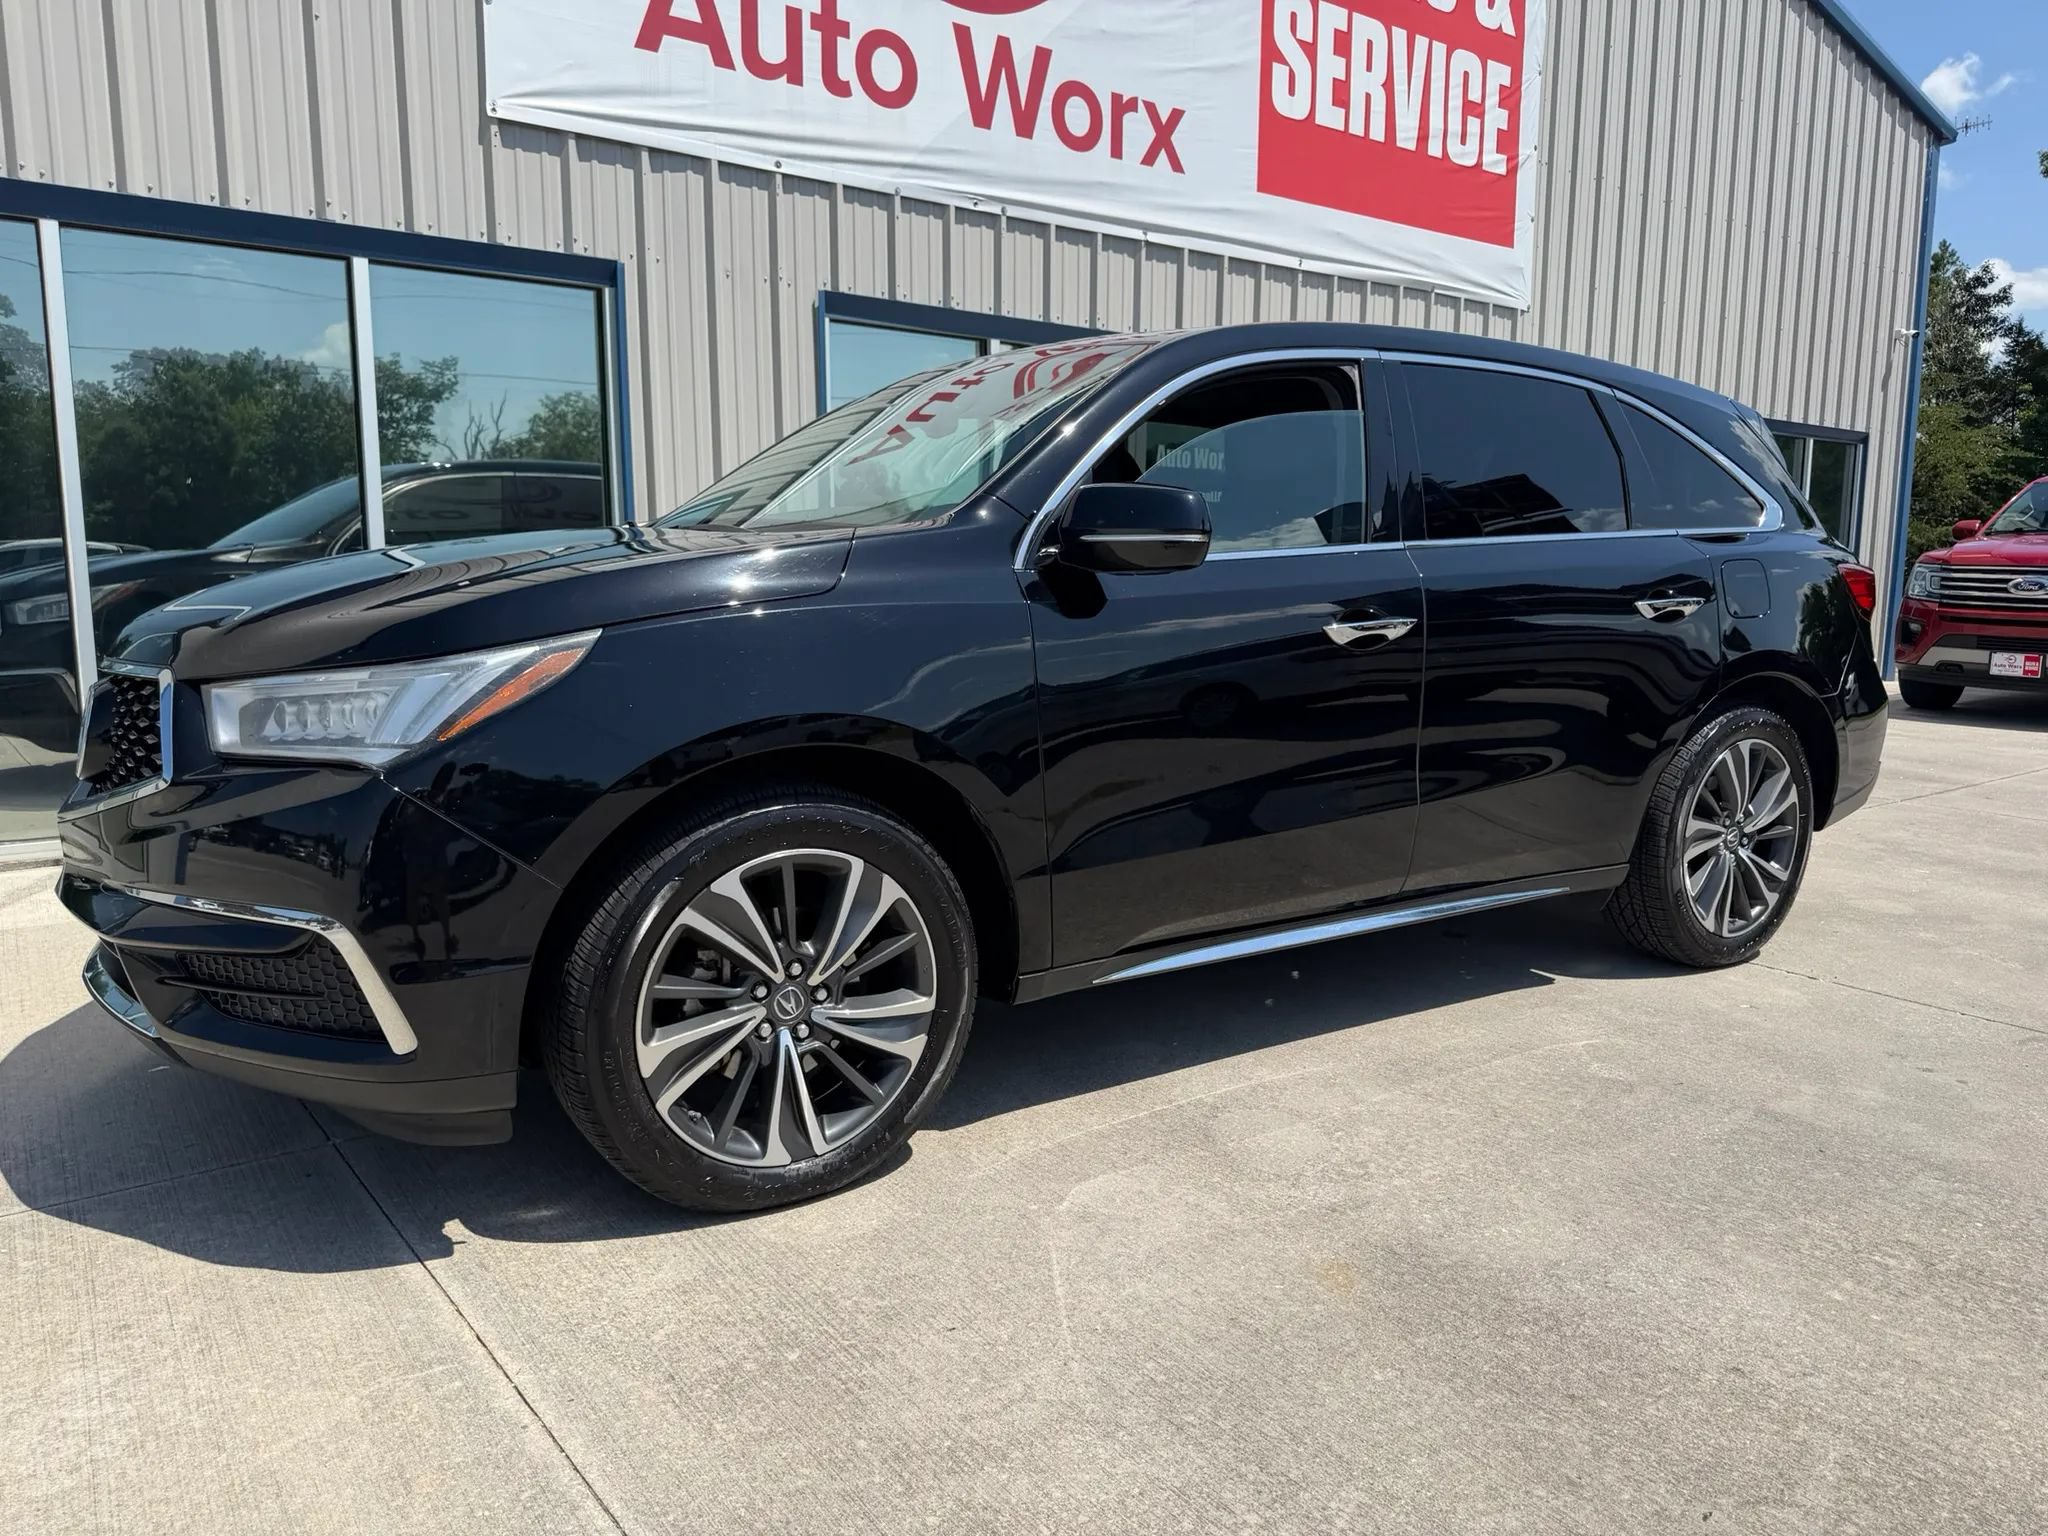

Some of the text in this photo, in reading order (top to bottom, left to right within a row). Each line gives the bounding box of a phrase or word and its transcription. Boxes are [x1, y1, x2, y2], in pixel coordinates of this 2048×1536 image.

[634, 0, 1187, 175] Auto Worx
[1271, 0, 1512, 176] SERVICE
[2017, 581, 2041, 591] Ford
